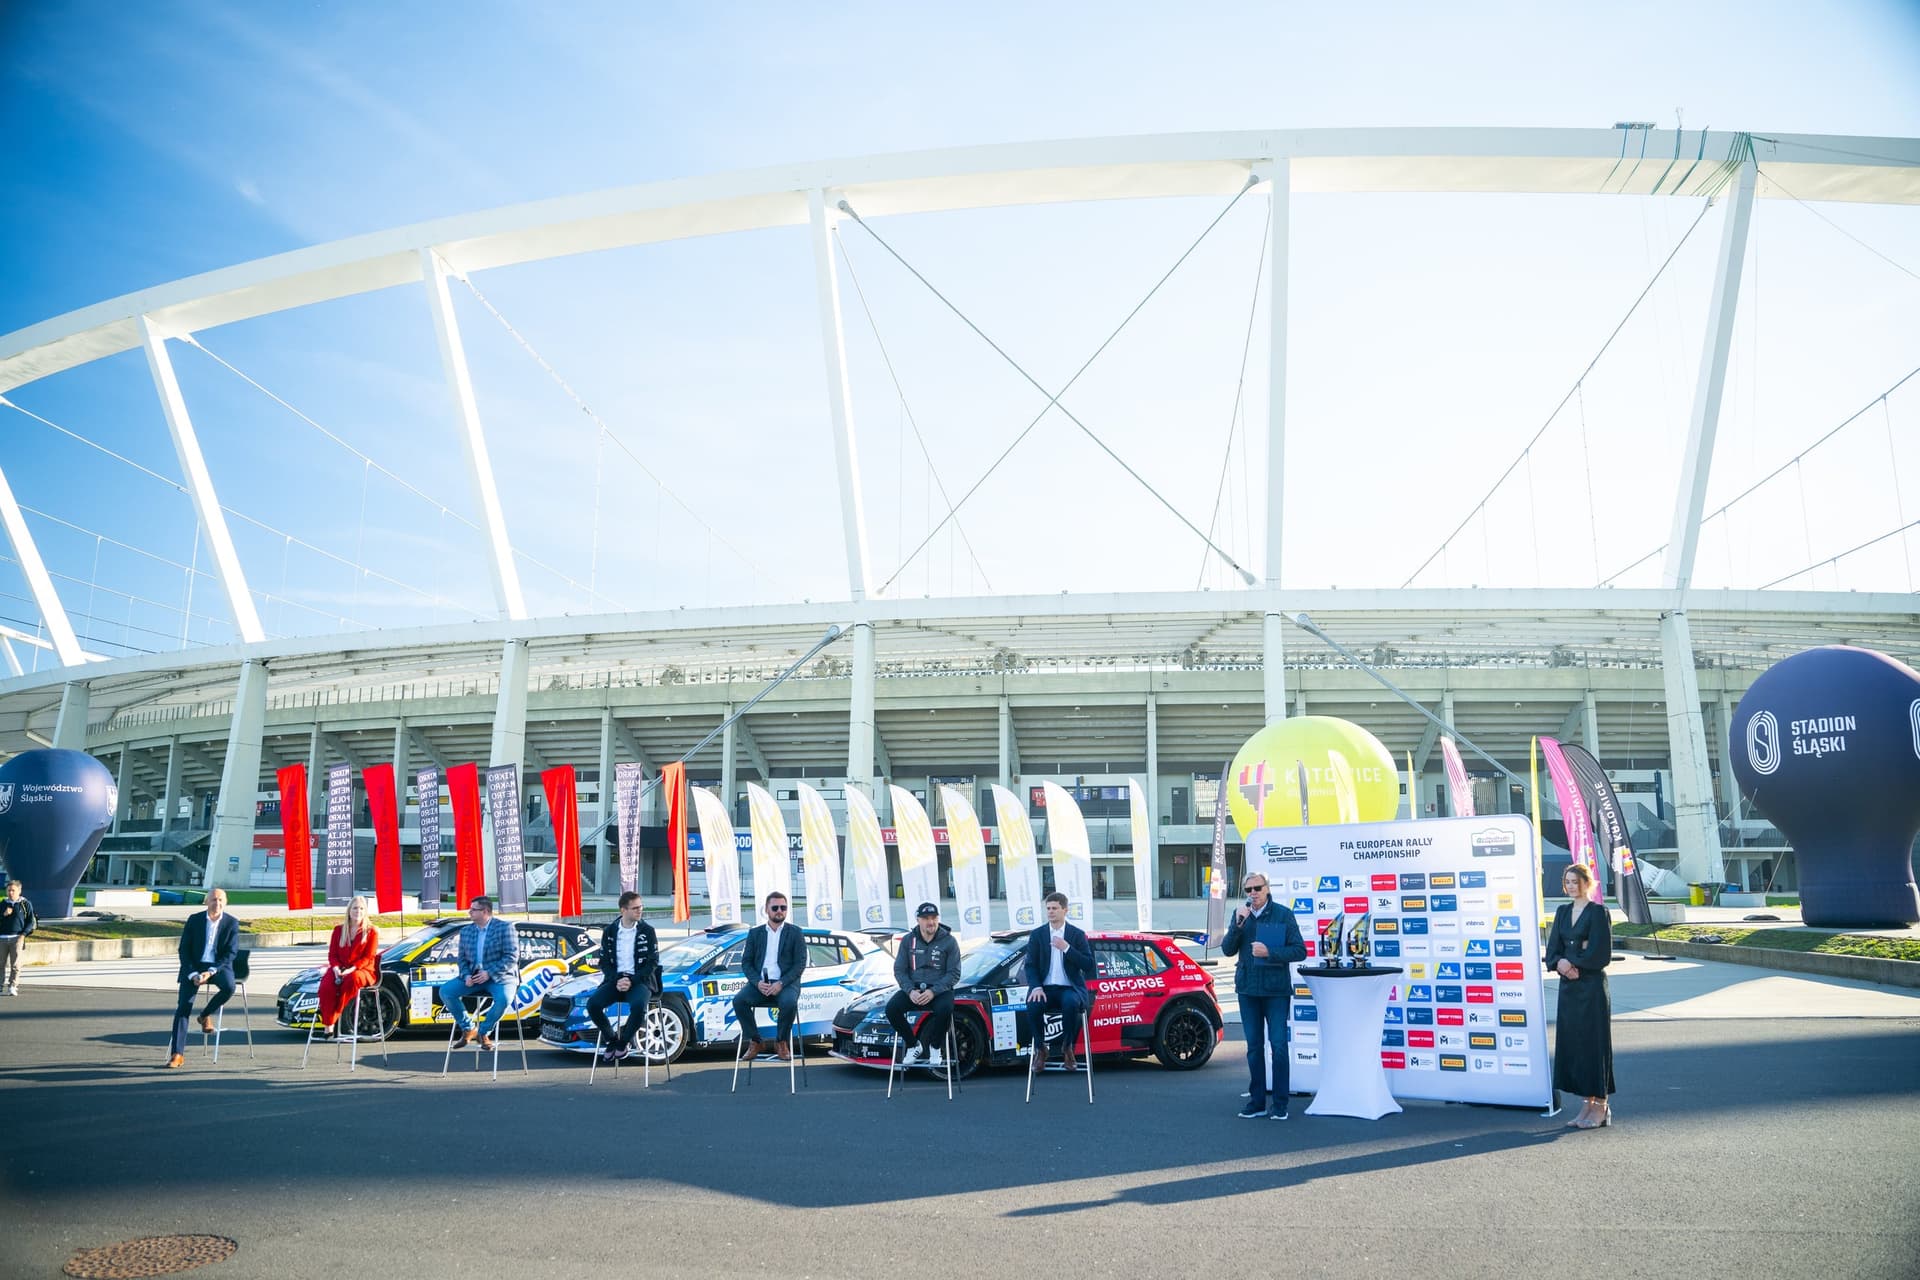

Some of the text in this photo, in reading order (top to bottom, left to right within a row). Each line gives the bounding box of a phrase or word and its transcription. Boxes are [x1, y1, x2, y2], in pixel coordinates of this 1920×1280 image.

[1791, 716, 1856, 736] STADION
[1792, 736, 1846, 758] ŚLĄSKI
[1286, 768, 1382, 783] KTOICE
[22, 784, 83, 793] Województwo
[20, 794, 53, 803] Śląskie
[1340, 838, 1432, 850] FIA EUROPEAN RALLY
[1354, 849, 1420, 860] CHAMPIONSHIP
[559, 938, 566, 956] 1
[416, 969, 422, 980] 1
[511, 968, 554, 1010] LOTTO
[707, 982, 714, 994] 1
[1099, 977, 1165, 992] GKFORGE
[995, 990, 1003, 1004] 1
[1094, 1014, 1142, 1027] INDUSTRIA
[1044, 1021, 1063, 1035] LOTT
